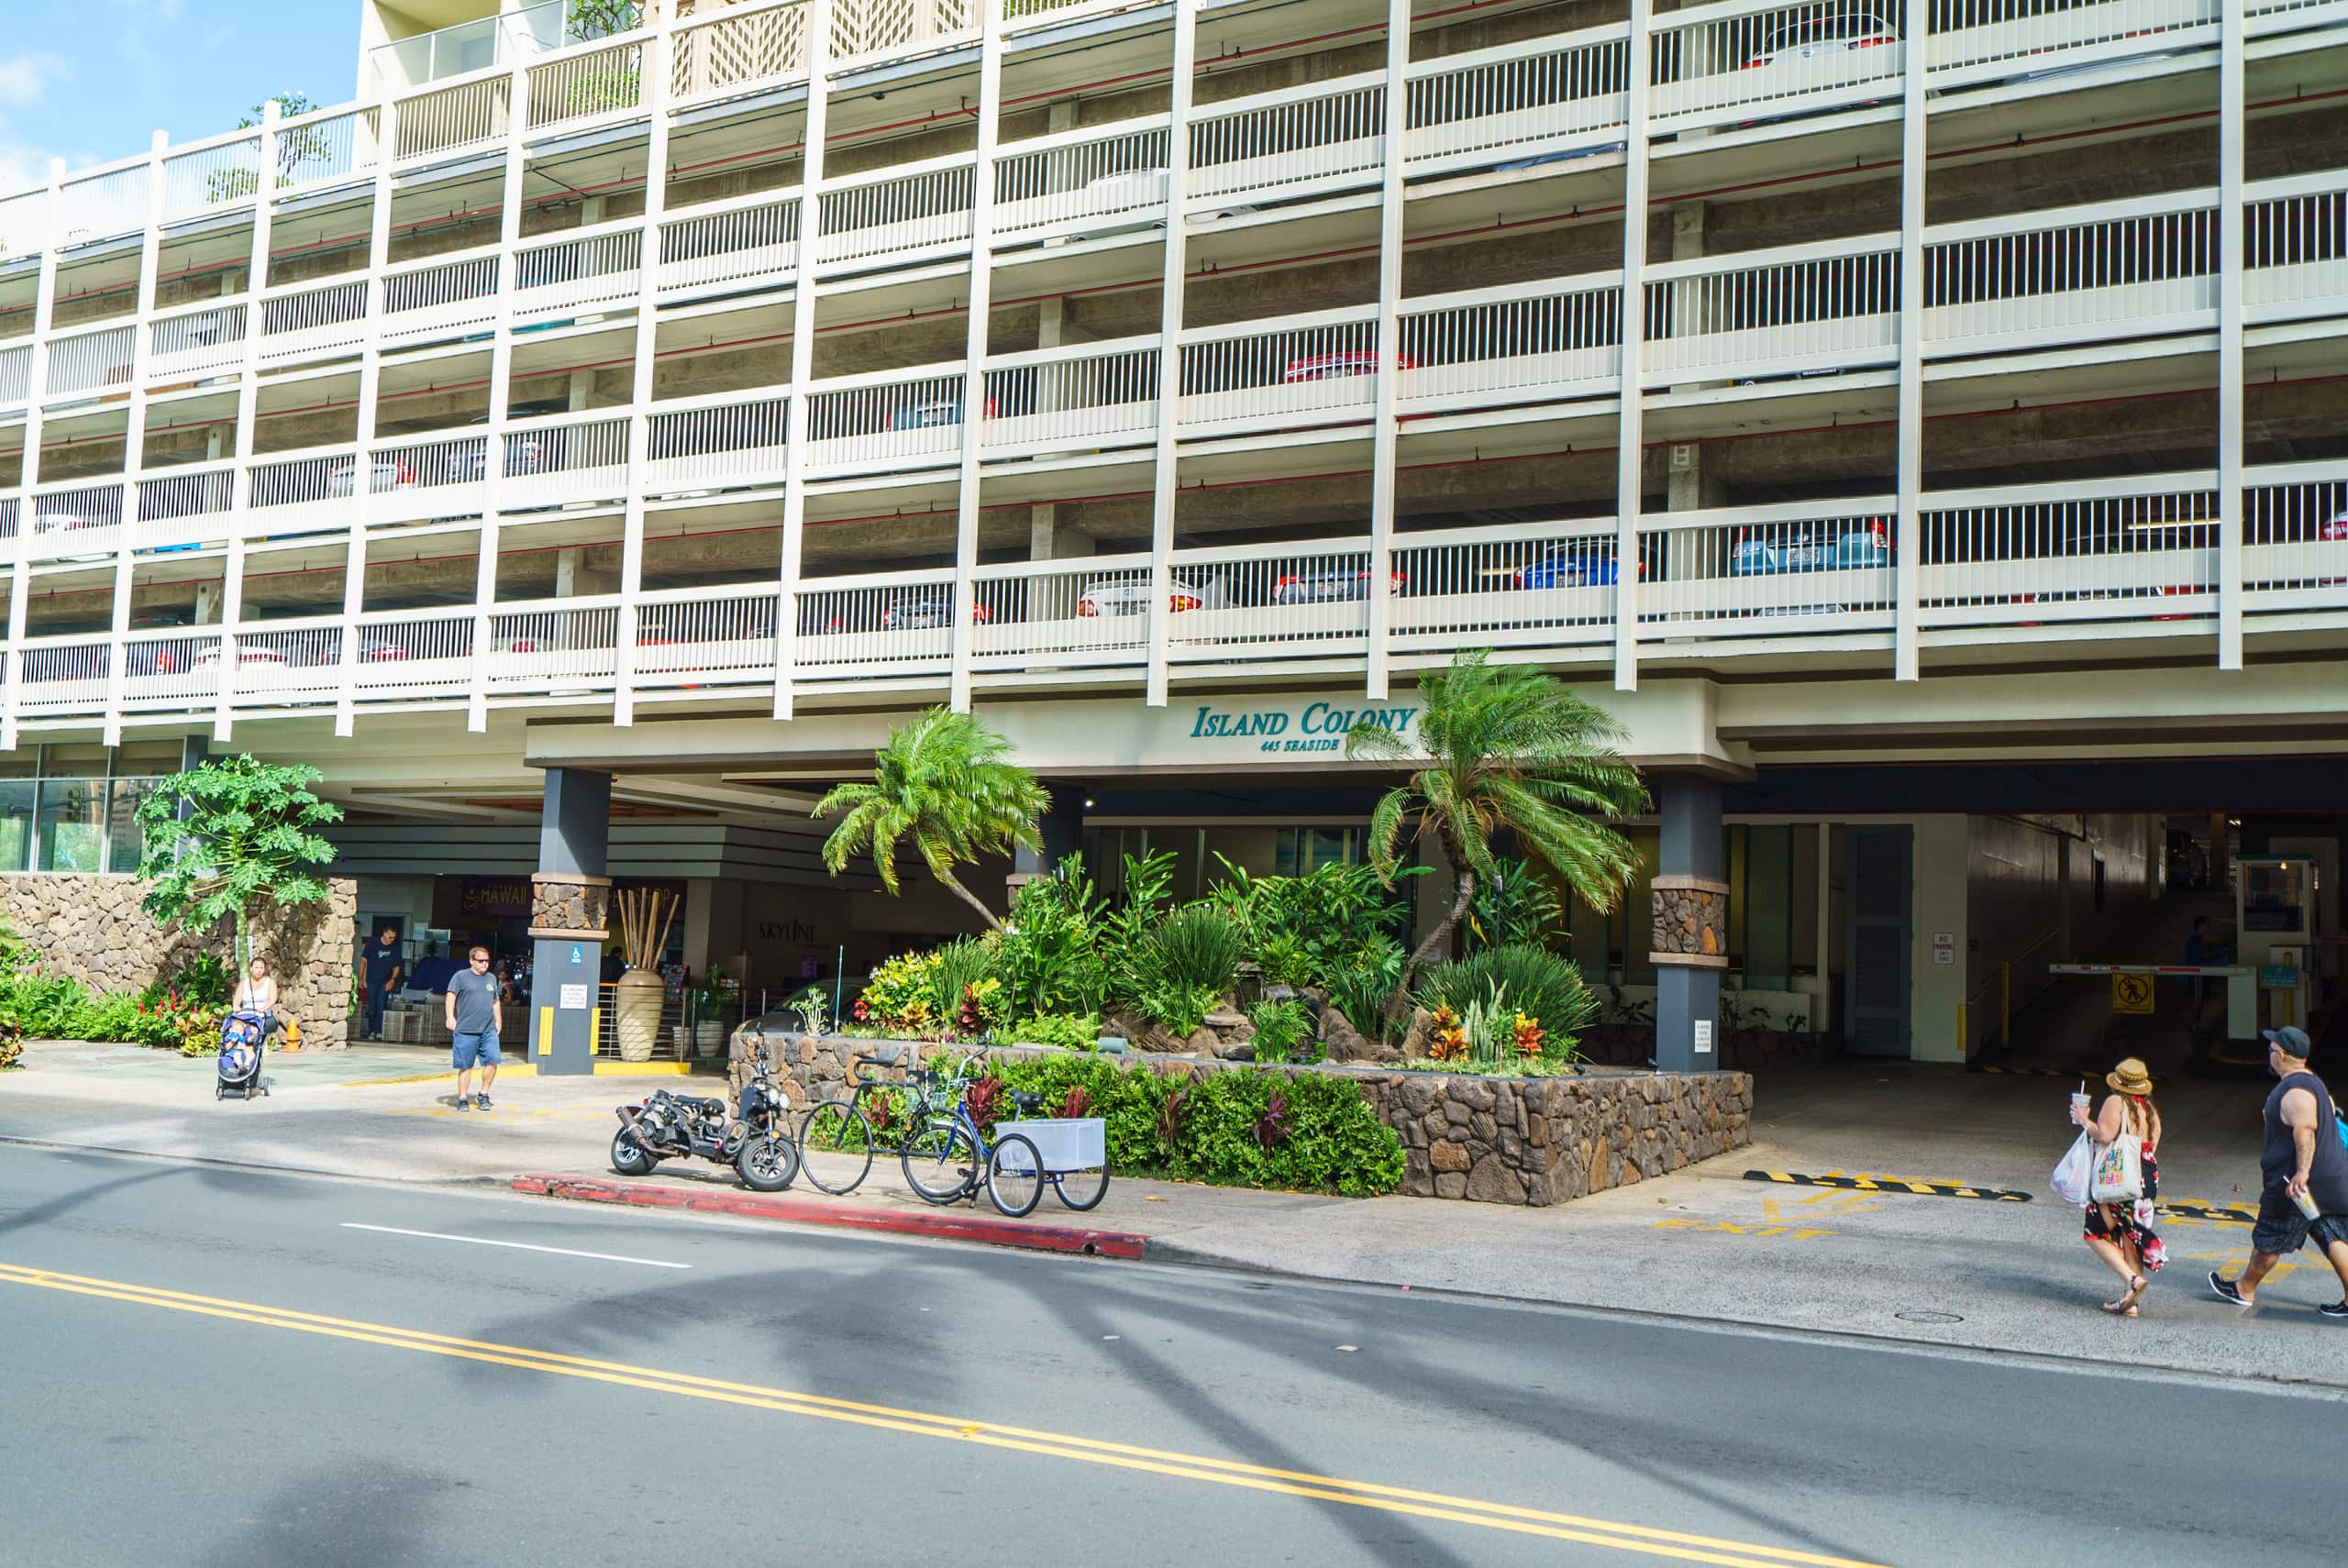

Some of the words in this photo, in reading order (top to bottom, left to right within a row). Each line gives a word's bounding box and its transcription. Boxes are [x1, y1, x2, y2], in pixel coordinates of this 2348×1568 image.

[1190, 706, 1289, 737] ISLAND
[1301, 702, 1419, 734] COLONY
[1260, 740, 1280, 752] 445
[1284, 738, 1340, 752] SEASIDE
[1649, 1218, 1840, 1240] EXIT
